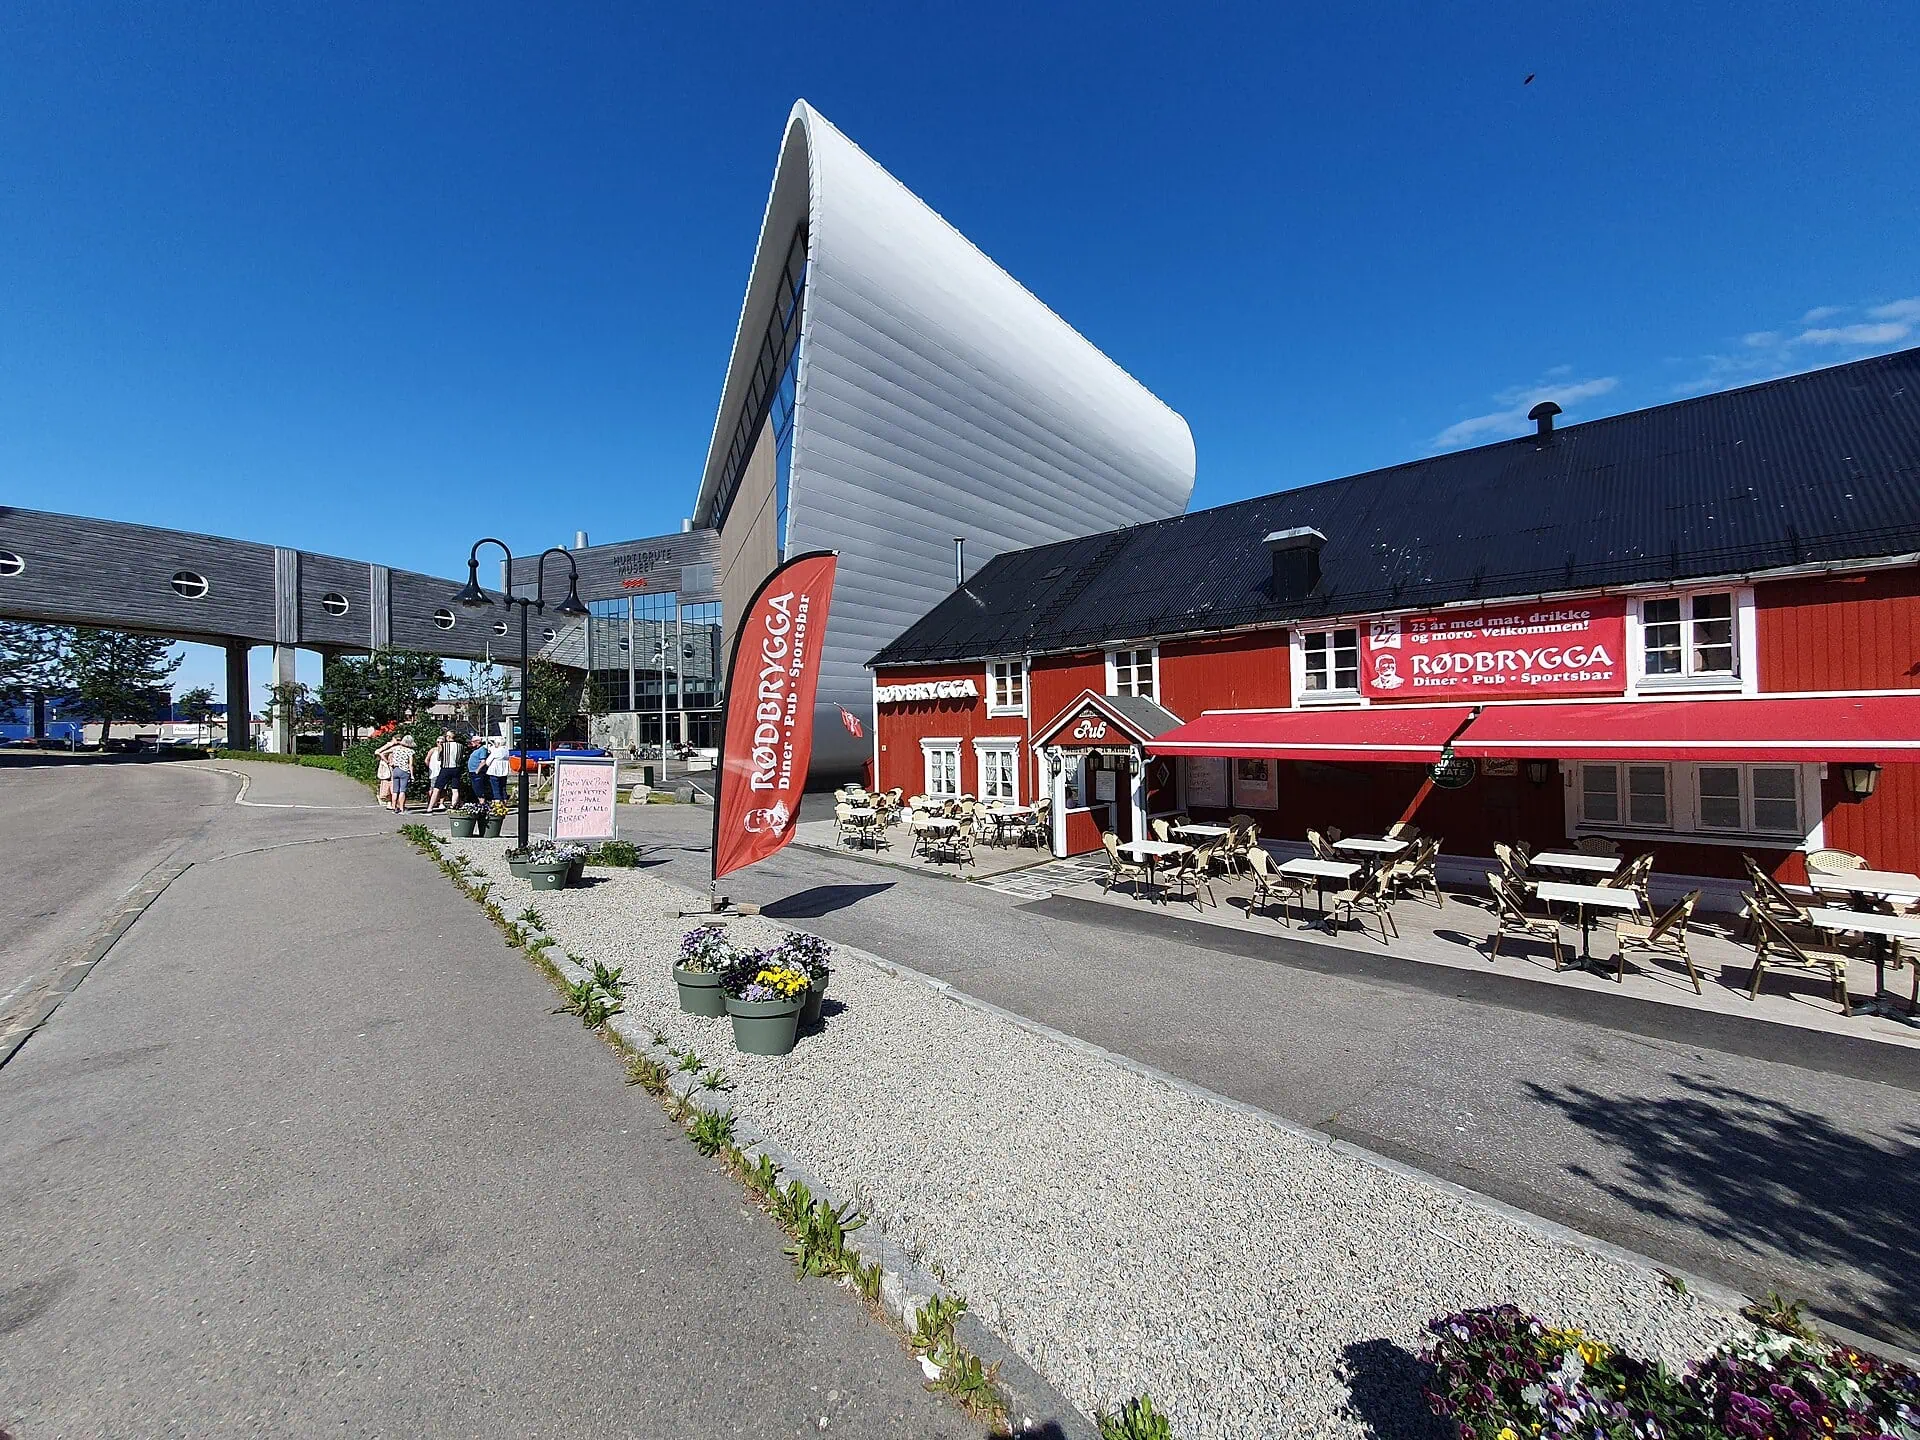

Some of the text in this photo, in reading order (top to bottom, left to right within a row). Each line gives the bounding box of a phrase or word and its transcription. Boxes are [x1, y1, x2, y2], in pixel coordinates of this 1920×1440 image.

[613, 548, 672, 567] HURTIGRUTE
[618, 562, 655, 576] MUSEET
[1412, 623, 1426, 632] 25
[1430, 622, 1446, 631] år
[1450, 617, 1483, 629] med
[1488, 615, 1525, 626] mat,
[1529, 610, 1591, 622] drikke
[1411, 619, 1589, 644] og moro. Velkommen!
[1410, 644, 1615, 675] RØDBRYGGA
[1413, 671, 1613, 687] Diner Pub Sportsbar
[750, 591, 795, 794] RØDBRYGGA
[778, 594, 810, 790] Diner Pub Sportsbar
[1073, 720, 1107, 739] Pub
[1434, 768, 1466, 776] STATE
